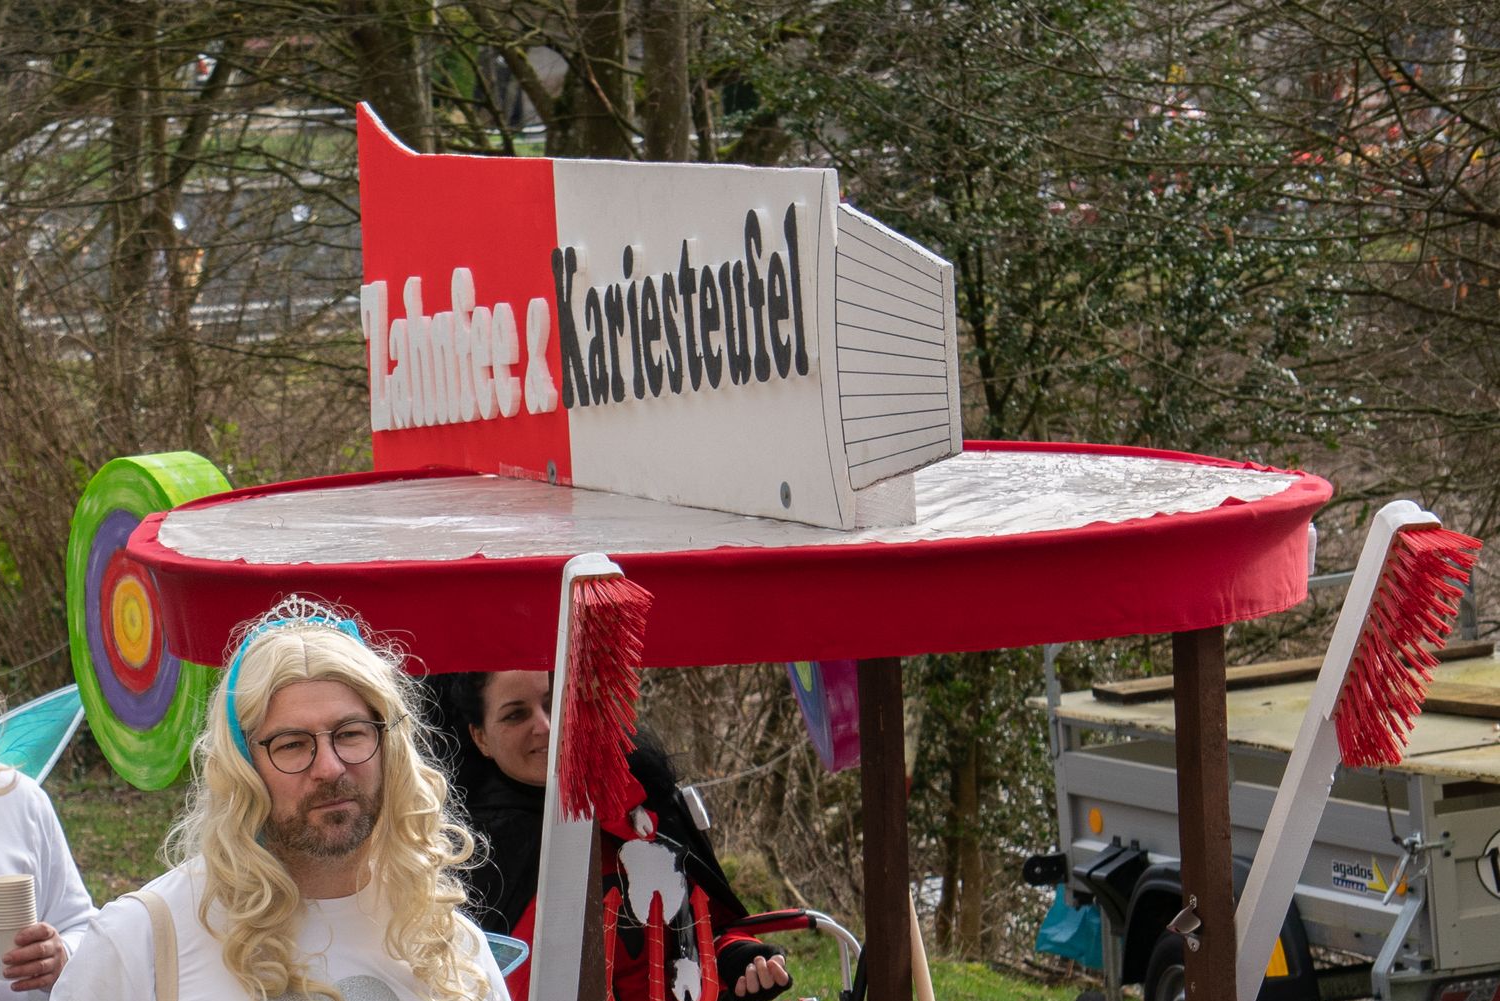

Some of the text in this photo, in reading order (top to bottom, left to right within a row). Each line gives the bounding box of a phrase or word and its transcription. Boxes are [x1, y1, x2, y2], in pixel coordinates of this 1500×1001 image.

[360, 202, 812, 433] Zahnfee & Kariesteufel
[1332, 861, 1374, 881] agados
